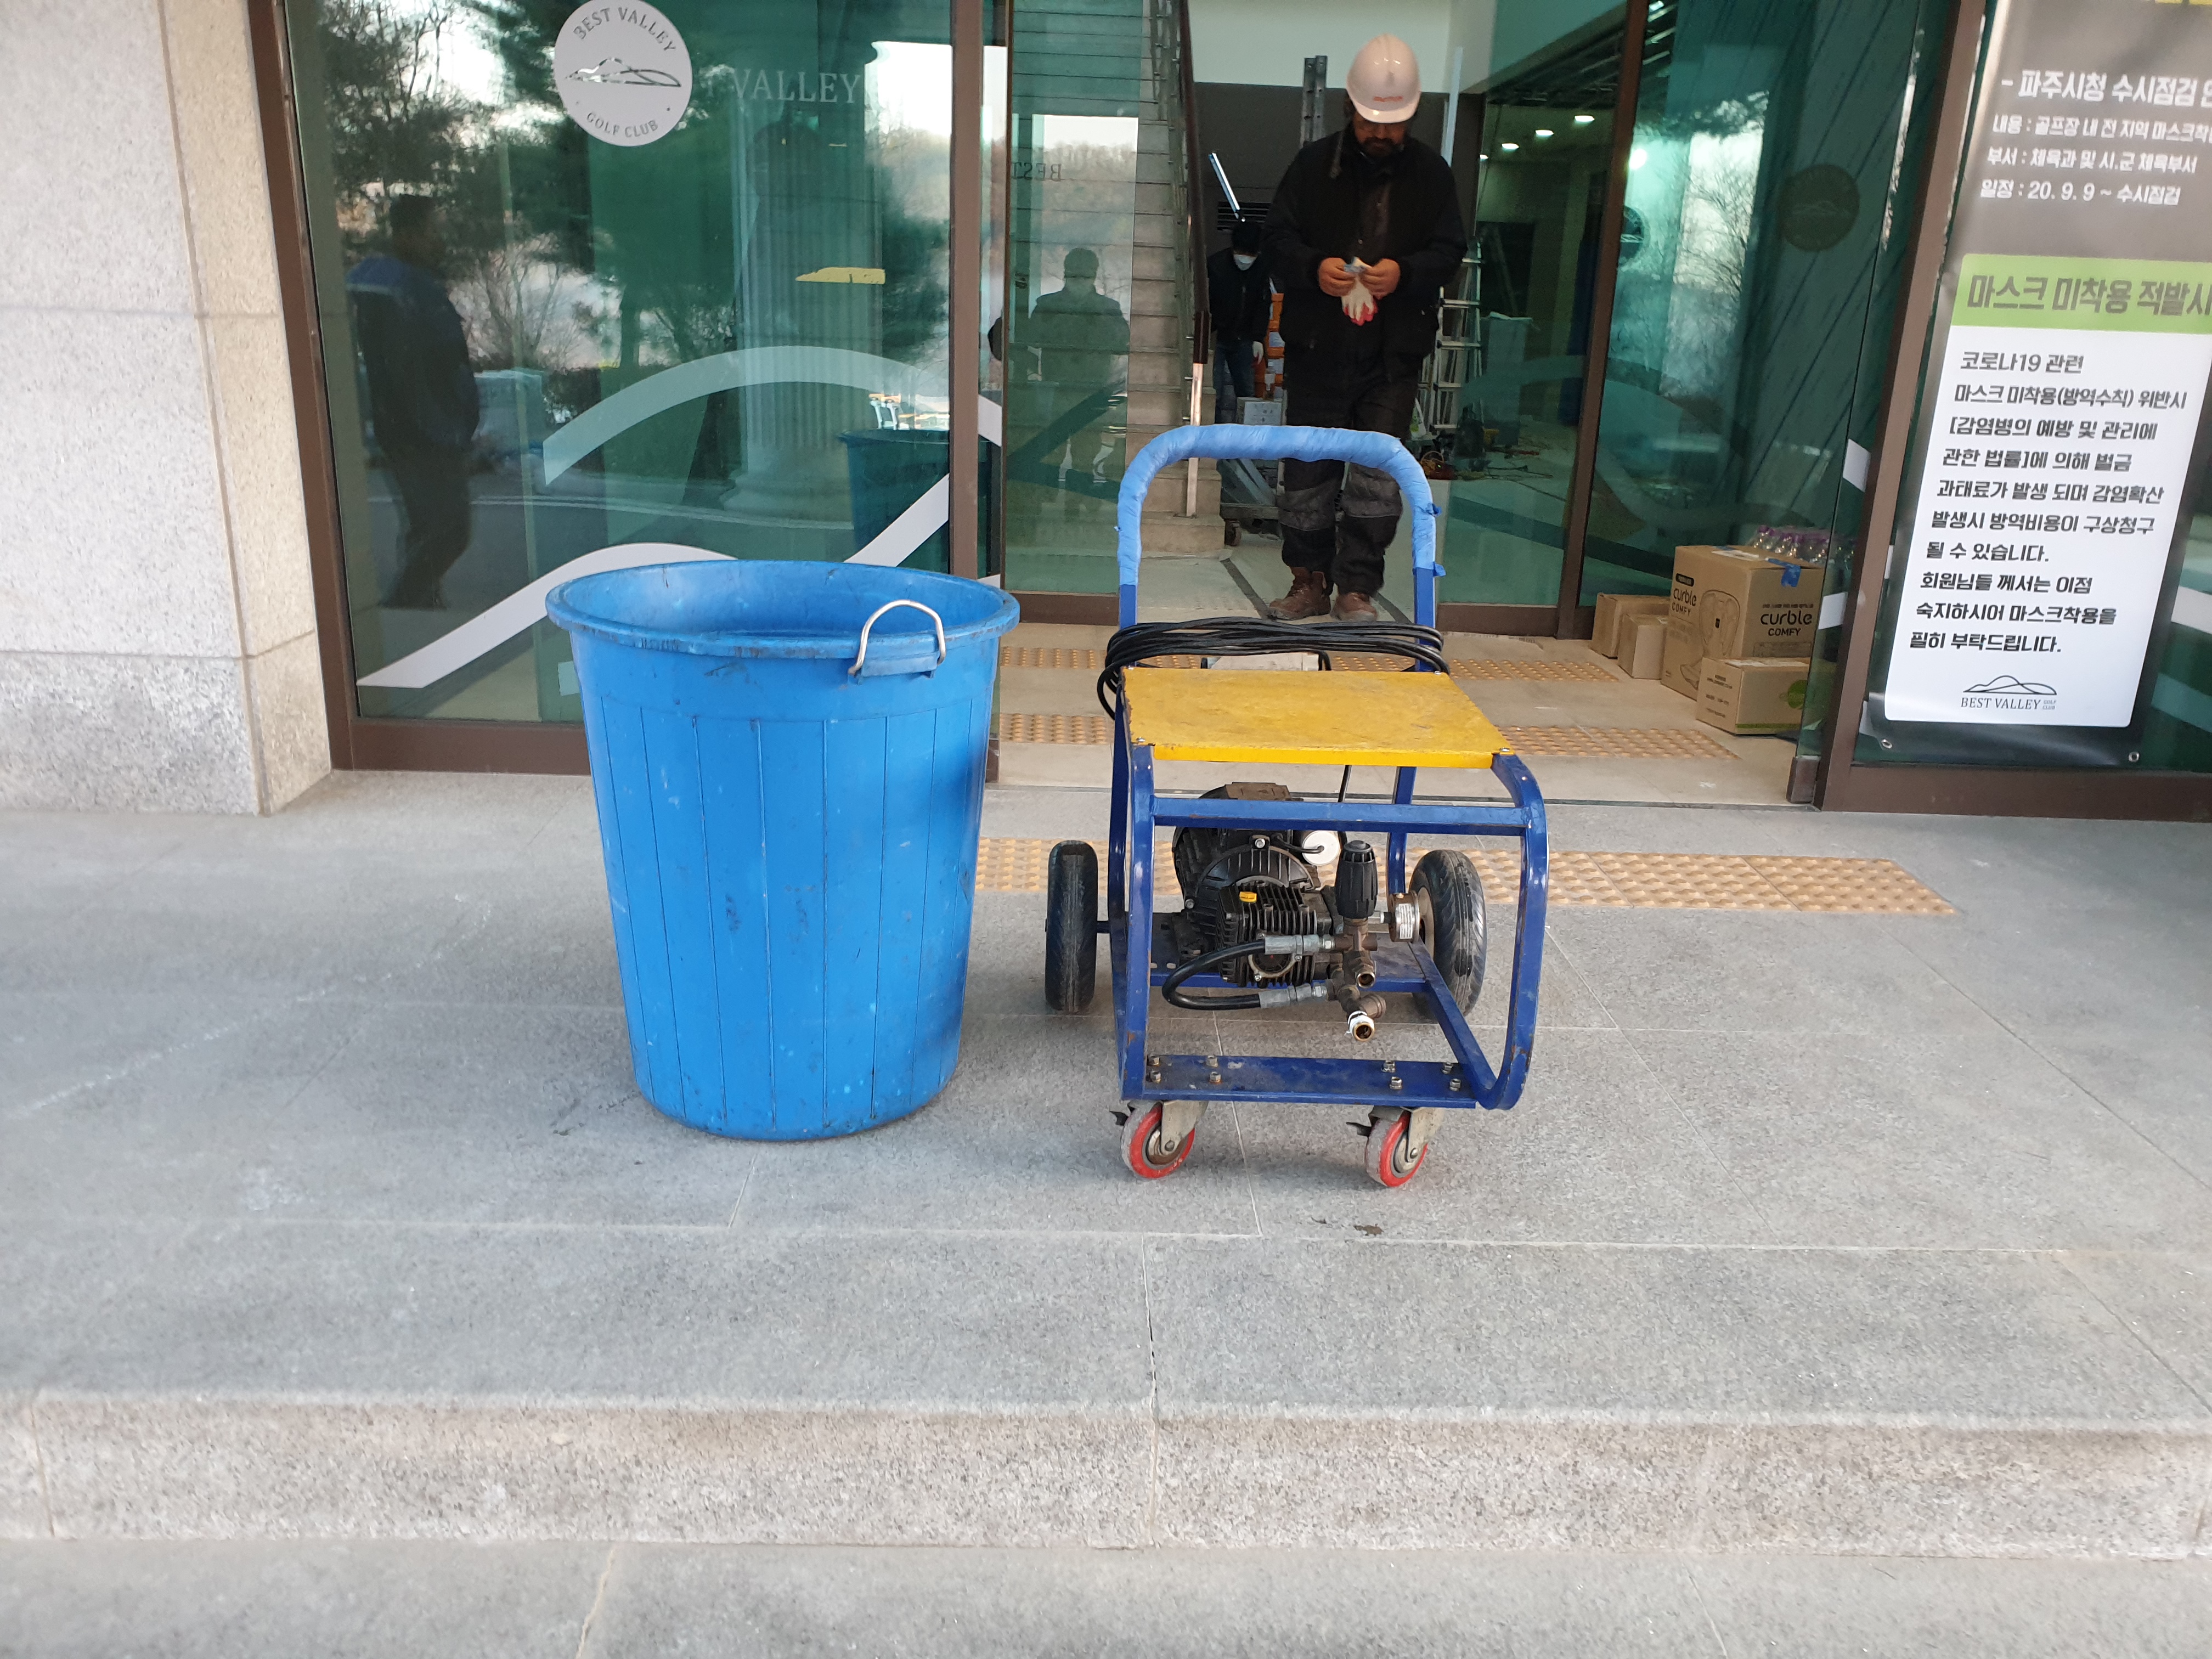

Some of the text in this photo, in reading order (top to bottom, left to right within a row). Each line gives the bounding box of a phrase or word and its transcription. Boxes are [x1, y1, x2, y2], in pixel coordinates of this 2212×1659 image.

[573, 6, 676, 52] BEST VALLEY
[732, 68, 861, 104] VALLEY
[2018, 69, 2107, 102] 파주시청
[2112, 74, 2198, 107] 수시점검
[586, 112, 659, 138] GOLF CLUB
[1992, 113, 2023, 134] 내용
[2035, 115, 2080, 137] 골프장
[2083, 117, 2099, 137] 내
[2152, 120, 2212, 144] 마스크착
[1987, 146, 2018, 166] 부서
[2030, 147, 2077, 168] 체육과
[2079, 149, 2096, 169] 및
[1980, 178, 2015, 199] 일정
[2117, 183, 2181, 206] 수시점검
[1967, 274, 2212, 317] 마스크 미착용 적발시
[1960, 351, 2084, 375] 코로나19 관련
[1954, 384, 2188, 409] 마스크 미착용(방역수칙) 위반시
[2036, 419, 2075, 438] 예방
[2077, 420, 2098, 439] 및
[2101, 421, 2158, 441] 관리에
[1942, 448, 1981, 467] 관한
[2052, 452, 2091, 470] 의해
[2094, 453, 2132, 472] 벌금
[1936, 479, 2165, 505] 과태료가 발생 되며 감염확산
[1931, 510, 2155, 535] 발생시 방역비용이 구상청구
[1926, 541, 2050, 562] 될 수 있습니다.
[1920, 571, 2094, 594] 회원님들 께서는 이점
[1671, 601, 1692, 617] COMFY
[1673, 587, 1697, 607] curble
[1760, 610, 1813, 626] curble
[1916, 602, 2117, 625] 숙지하시어 마스크착용을
[1768, 627, 1802, 637] COMFY
[1909, 631, 2062, 653] 필히 부탁드립니다.
[1960, 697, 2042, 710] BEST VALLEY
